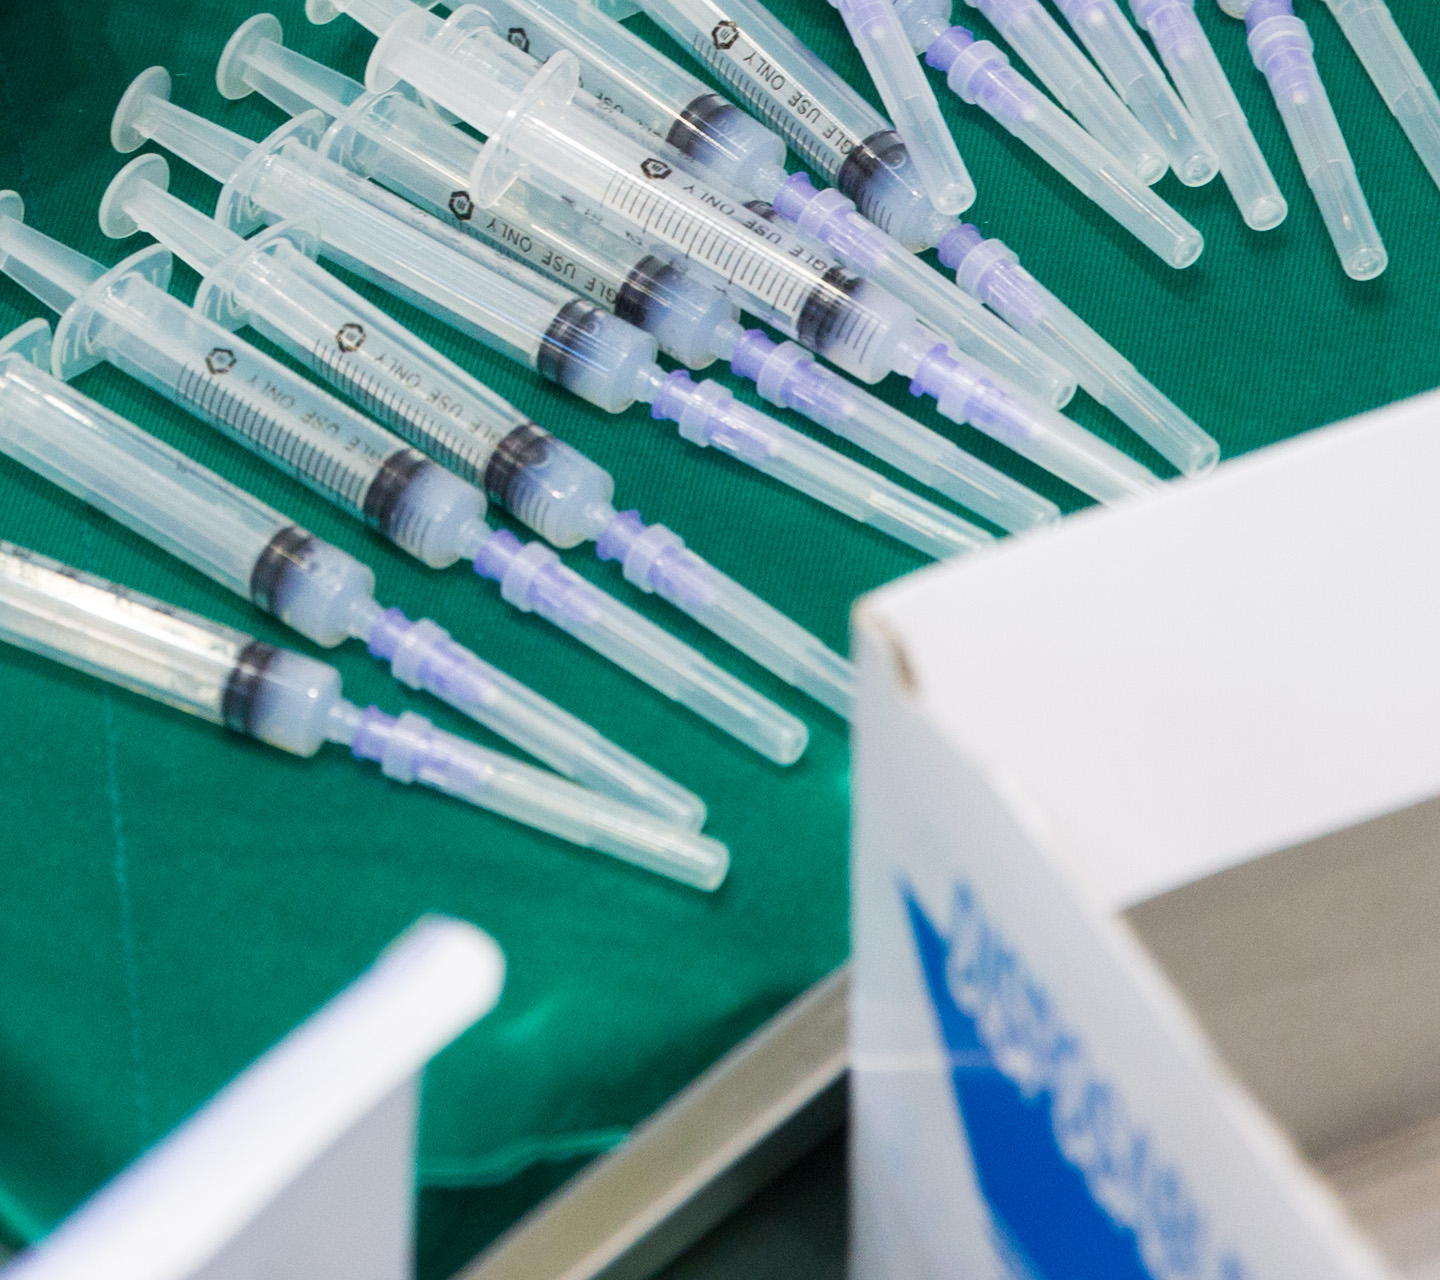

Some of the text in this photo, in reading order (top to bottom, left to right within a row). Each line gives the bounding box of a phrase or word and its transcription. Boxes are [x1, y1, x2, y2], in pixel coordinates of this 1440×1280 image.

[743, 51, 786, 90] ONLY
[788, 91, 820, 124] USE
[684, 184, 735, 215] ONLY
[487, 218, 533, 252] ONLY
[743, 220, 782, 244] USE
[541, 251, 576, 279] USE
[375, 354, 420, 389] ONLY
[427, 390, 463, 417] USE
